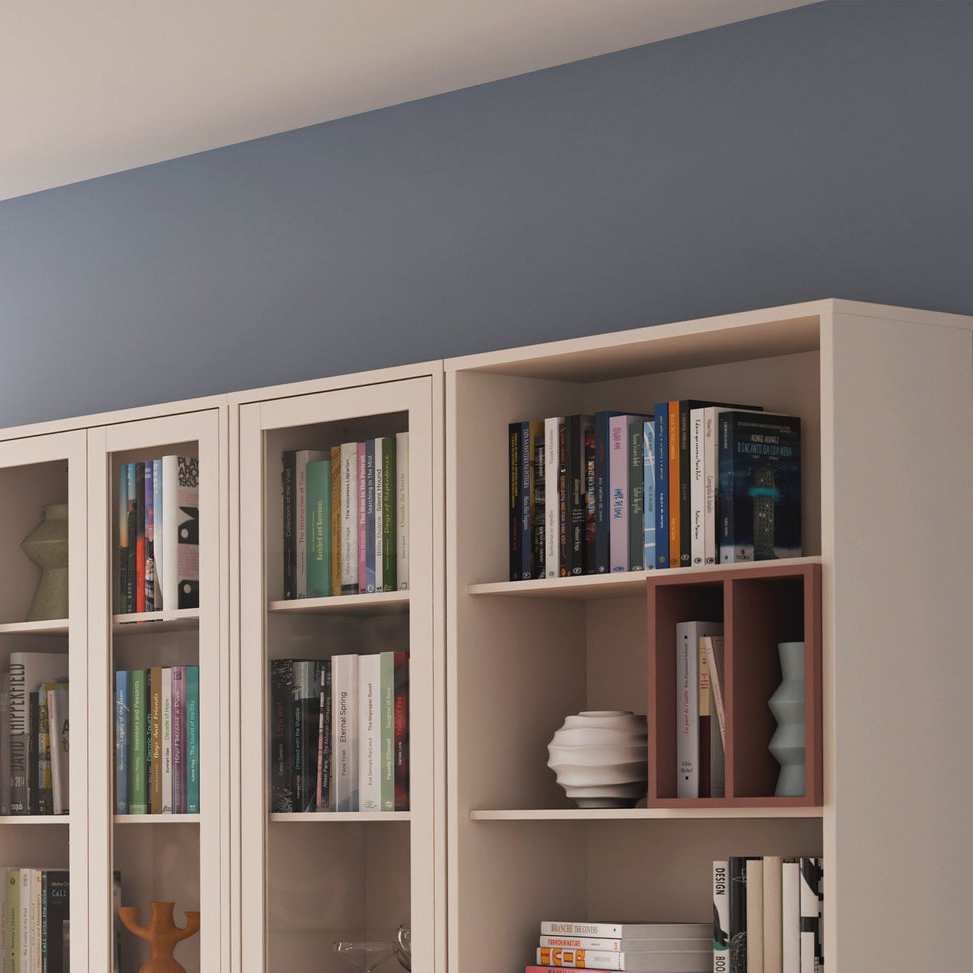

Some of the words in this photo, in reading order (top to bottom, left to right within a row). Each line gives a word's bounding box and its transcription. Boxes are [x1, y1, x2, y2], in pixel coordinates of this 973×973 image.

[10, 663, 25, 737] CHIPPERFIELD
[340, 691, 348, 716] Spring
[340, 717, 348, 743] Eternal
[10, 741, 25, 772] DAVID
[715, 867, 725, 896] DESIGN
[551, 923, 573, 933] BRANCHE
[574, 925, 582, 933] THE
[582, 926, 598, 934] COVERS
